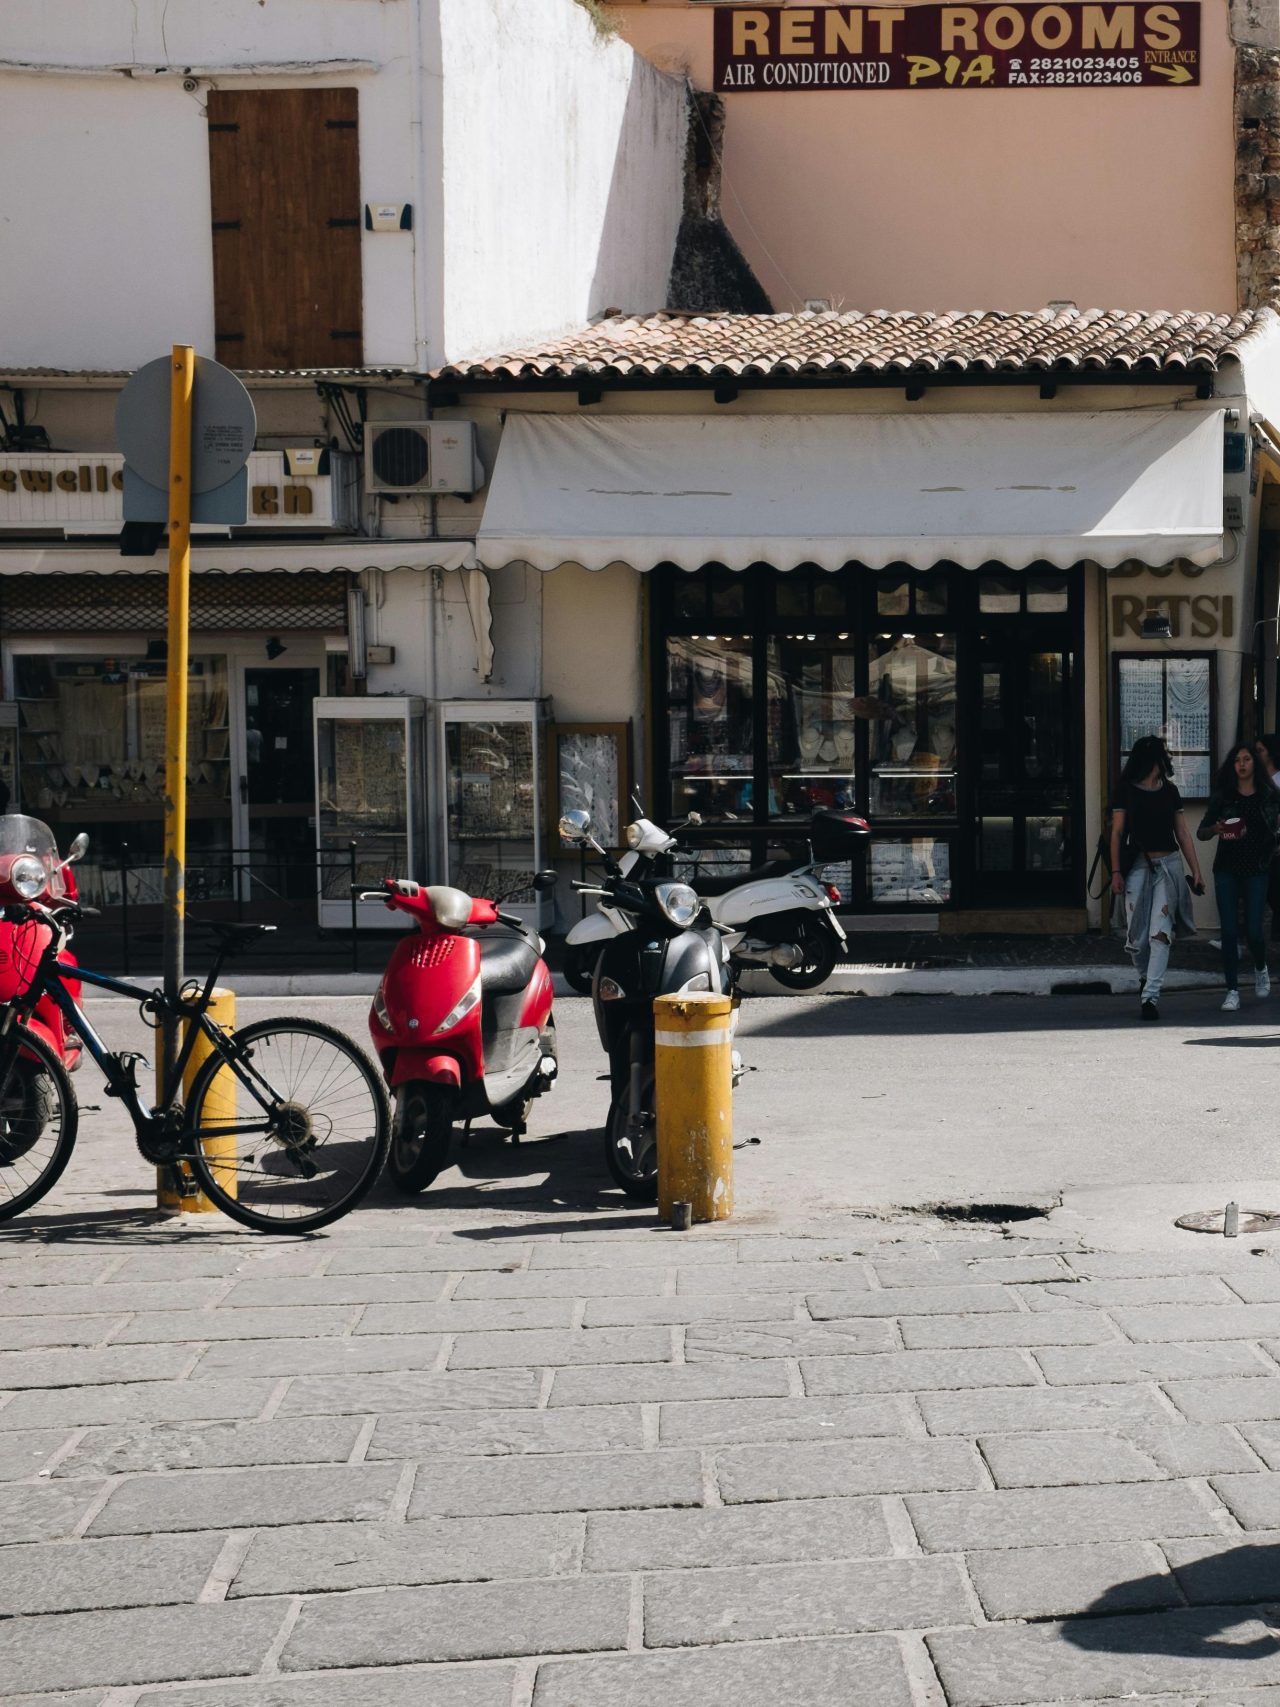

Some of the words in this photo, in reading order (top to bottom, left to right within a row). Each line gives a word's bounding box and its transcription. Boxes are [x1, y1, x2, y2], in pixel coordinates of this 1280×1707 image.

[731, 9, 905, 56] RENT
[941, 5, 1181, 51] ROOMS
[1030, 57, 1140, 70] 2821023405
[1144, 50, 1197, 63] ENTRANCE
[723, 62, 755, 86] AIR
[763, 61, 890, 85] CONDITIONED
[906, 54, 996, 86] PIA
[1008, 71, 1142, 84] FAX:2821023406
